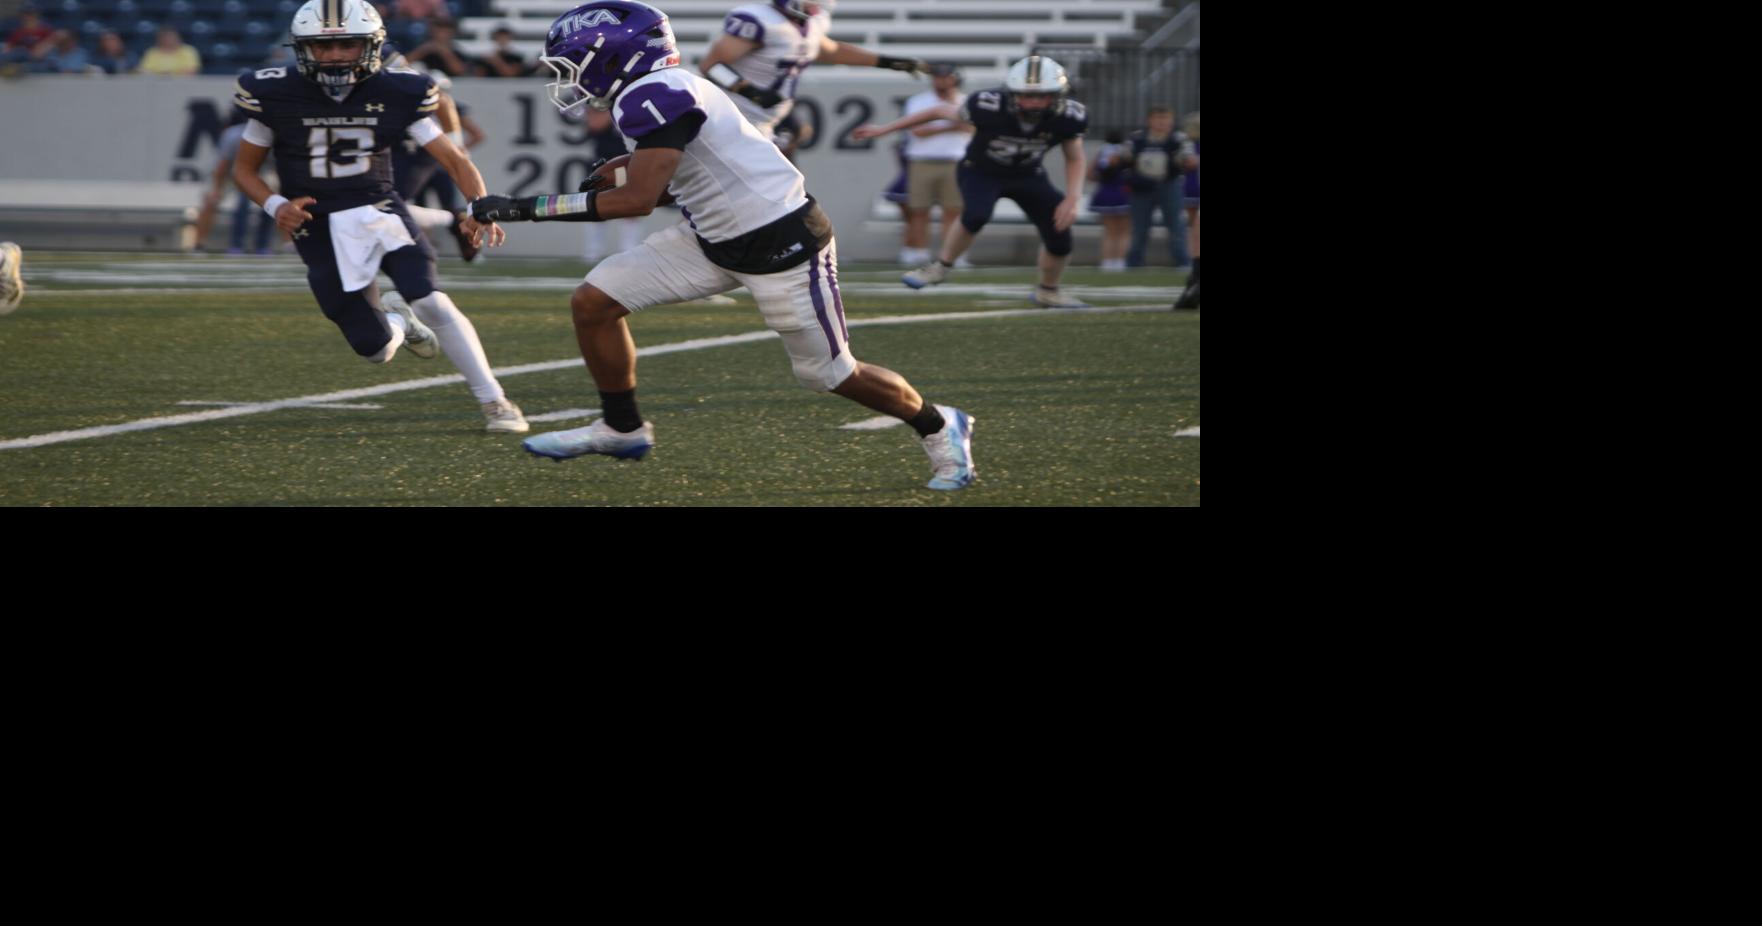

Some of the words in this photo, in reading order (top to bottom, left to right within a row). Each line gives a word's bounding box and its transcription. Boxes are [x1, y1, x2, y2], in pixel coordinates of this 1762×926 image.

[560, 9, 622, 36] TKA
[641, 99, 667, 126] 1
[308, 128, 374, 178] 13
